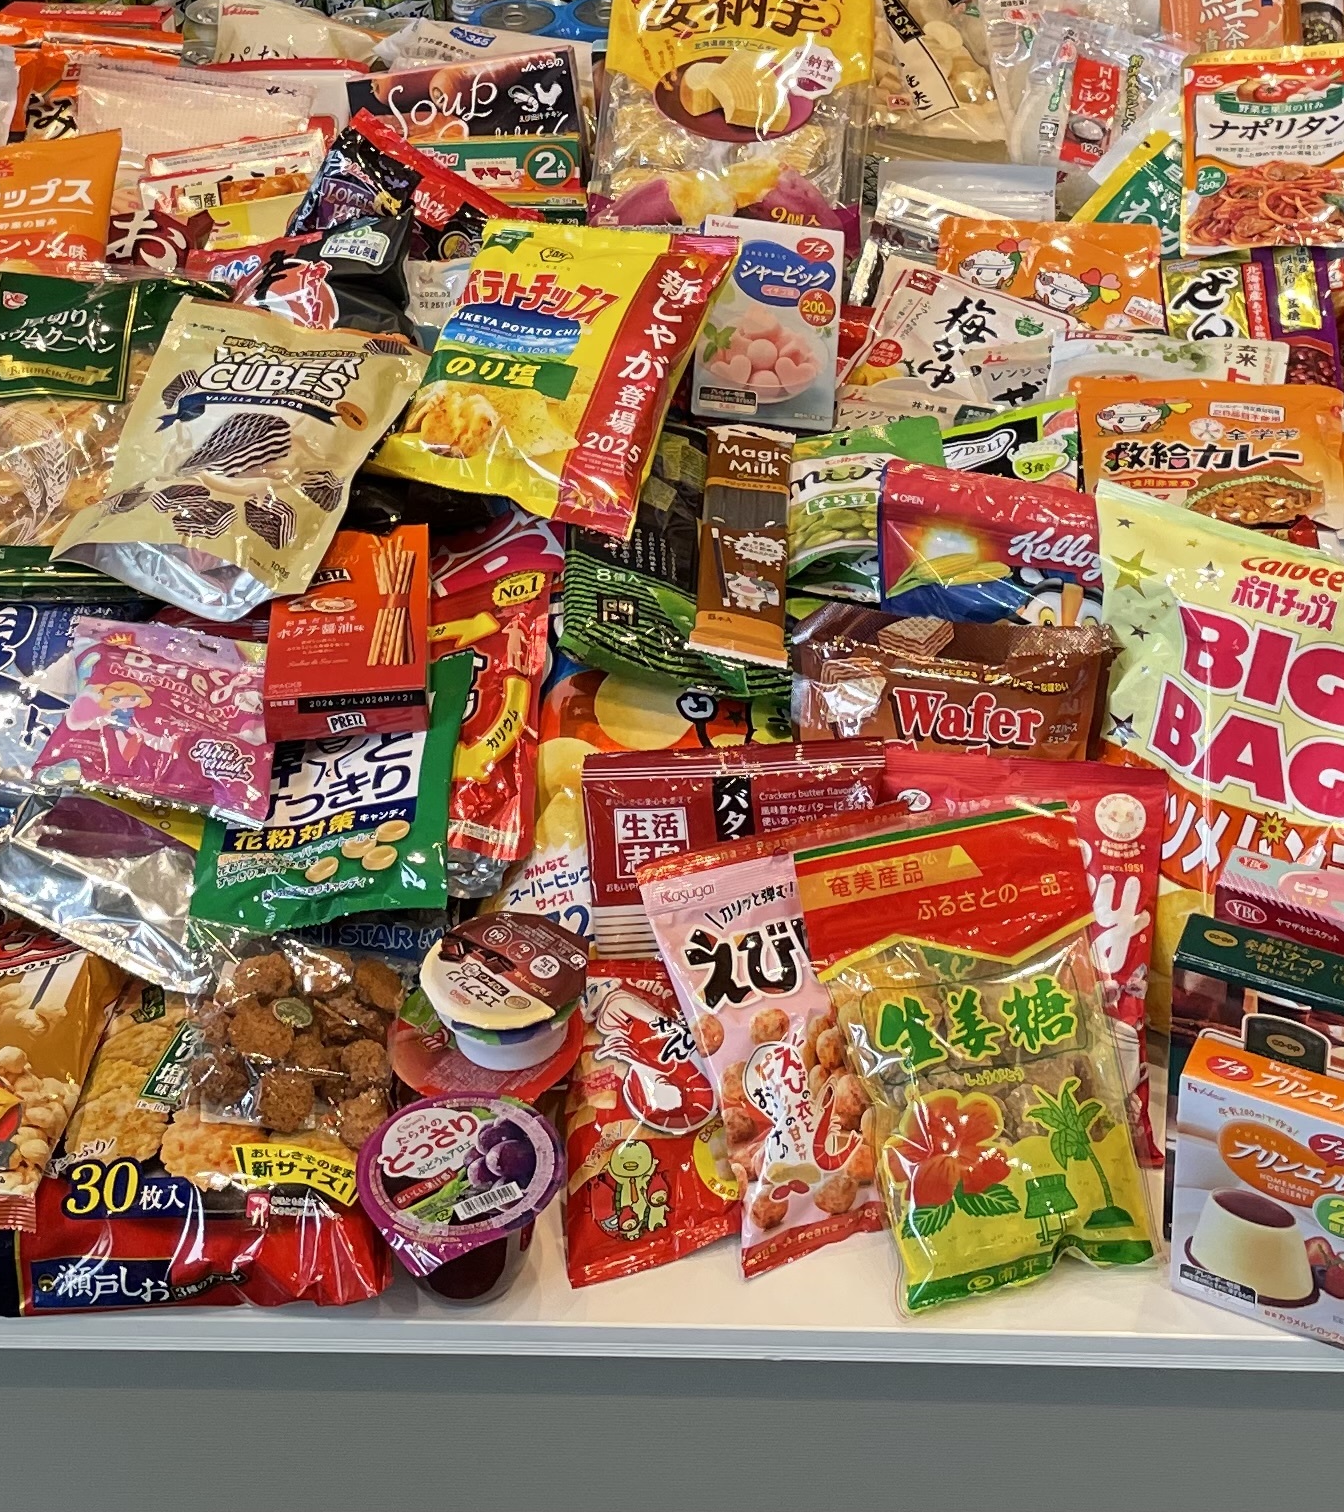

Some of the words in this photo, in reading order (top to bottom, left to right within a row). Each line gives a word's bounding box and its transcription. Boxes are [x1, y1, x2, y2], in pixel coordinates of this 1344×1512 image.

[1196, 74, 1224, 86] CGC
[803, 238, 832, 259] プチ
[737, 259, 830, 288] シャービック
[464, 269, 622, 324] ポテトチップス
[501, 320, 552, 338] POTATO
[199, 365, 350, 399] CUBES
[446, 356, 544, 387] のり塩
[206, 394, 261, 405] VANILLA
[582, 432, 642, 466] 2025
[717, 442, 790, 464] Magic
[728, 460, 781, 478] Milk
[900, 494, 924, 506] OPEN
[498, 578, 542, 602] No.1
[596, 568, 641, 583] 8個入
[1231, 577, 1338, 629] ポテトチップス
[330, 713, 366, 731] PRETZ
[892, 688, 1043, 748] Wafer
[359, 808, 407, 822] キャンディ
[619, 809, 679, 841] 生活
[233, 812, 354, 852] 花粉対策
[523, 855, 570, 882] みんなで
[828, 864, 926, 897] 奄美産品
[659, 883, 716, 906] Kasugai
[916, 875, 1062, 919] ふるさとの一品
[1231, 904, 1262, 924] YBC
[875, 979, 1078, 1068] 生姜糖
[380, 1116, 478, 1179] どっさり
[250, 1146, 356, 1180] おいしさそのまま
[68, 1160, 138, 1214] 30
[140, 1185, 186, 1208] 枚入
[250, 1158, 356, 1200] 新サイズ!
